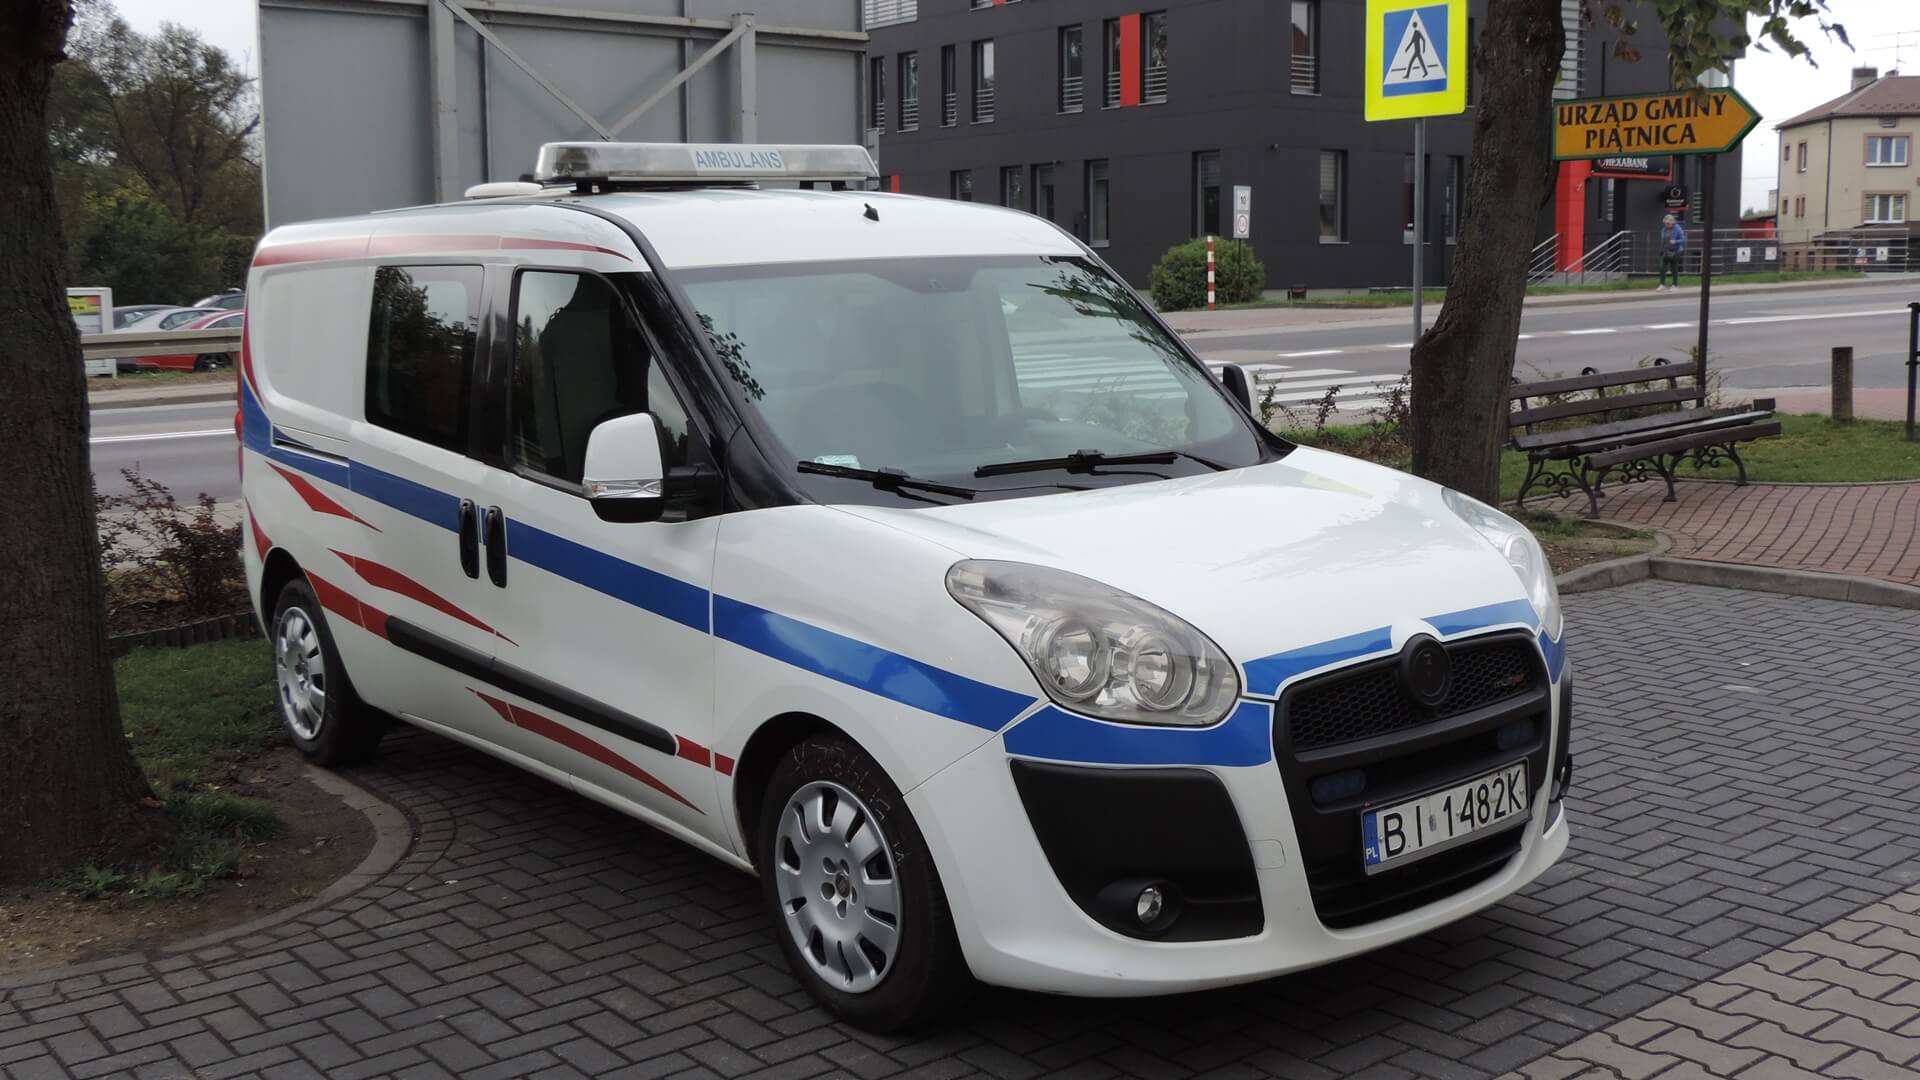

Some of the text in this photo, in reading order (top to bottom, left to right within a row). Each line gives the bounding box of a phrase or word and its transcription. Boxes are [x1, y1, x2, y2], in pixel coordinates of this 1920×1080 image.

[1559, 94, 1727, 127] URZĄD GMINY
[1585, 122, 1697, 153] PIĄTNICA
[695, 151, 783, 169] AMBULANS
[1383, 768, 1523, 858] BI 1482K
[1365, 847, 1378, 860] PL
